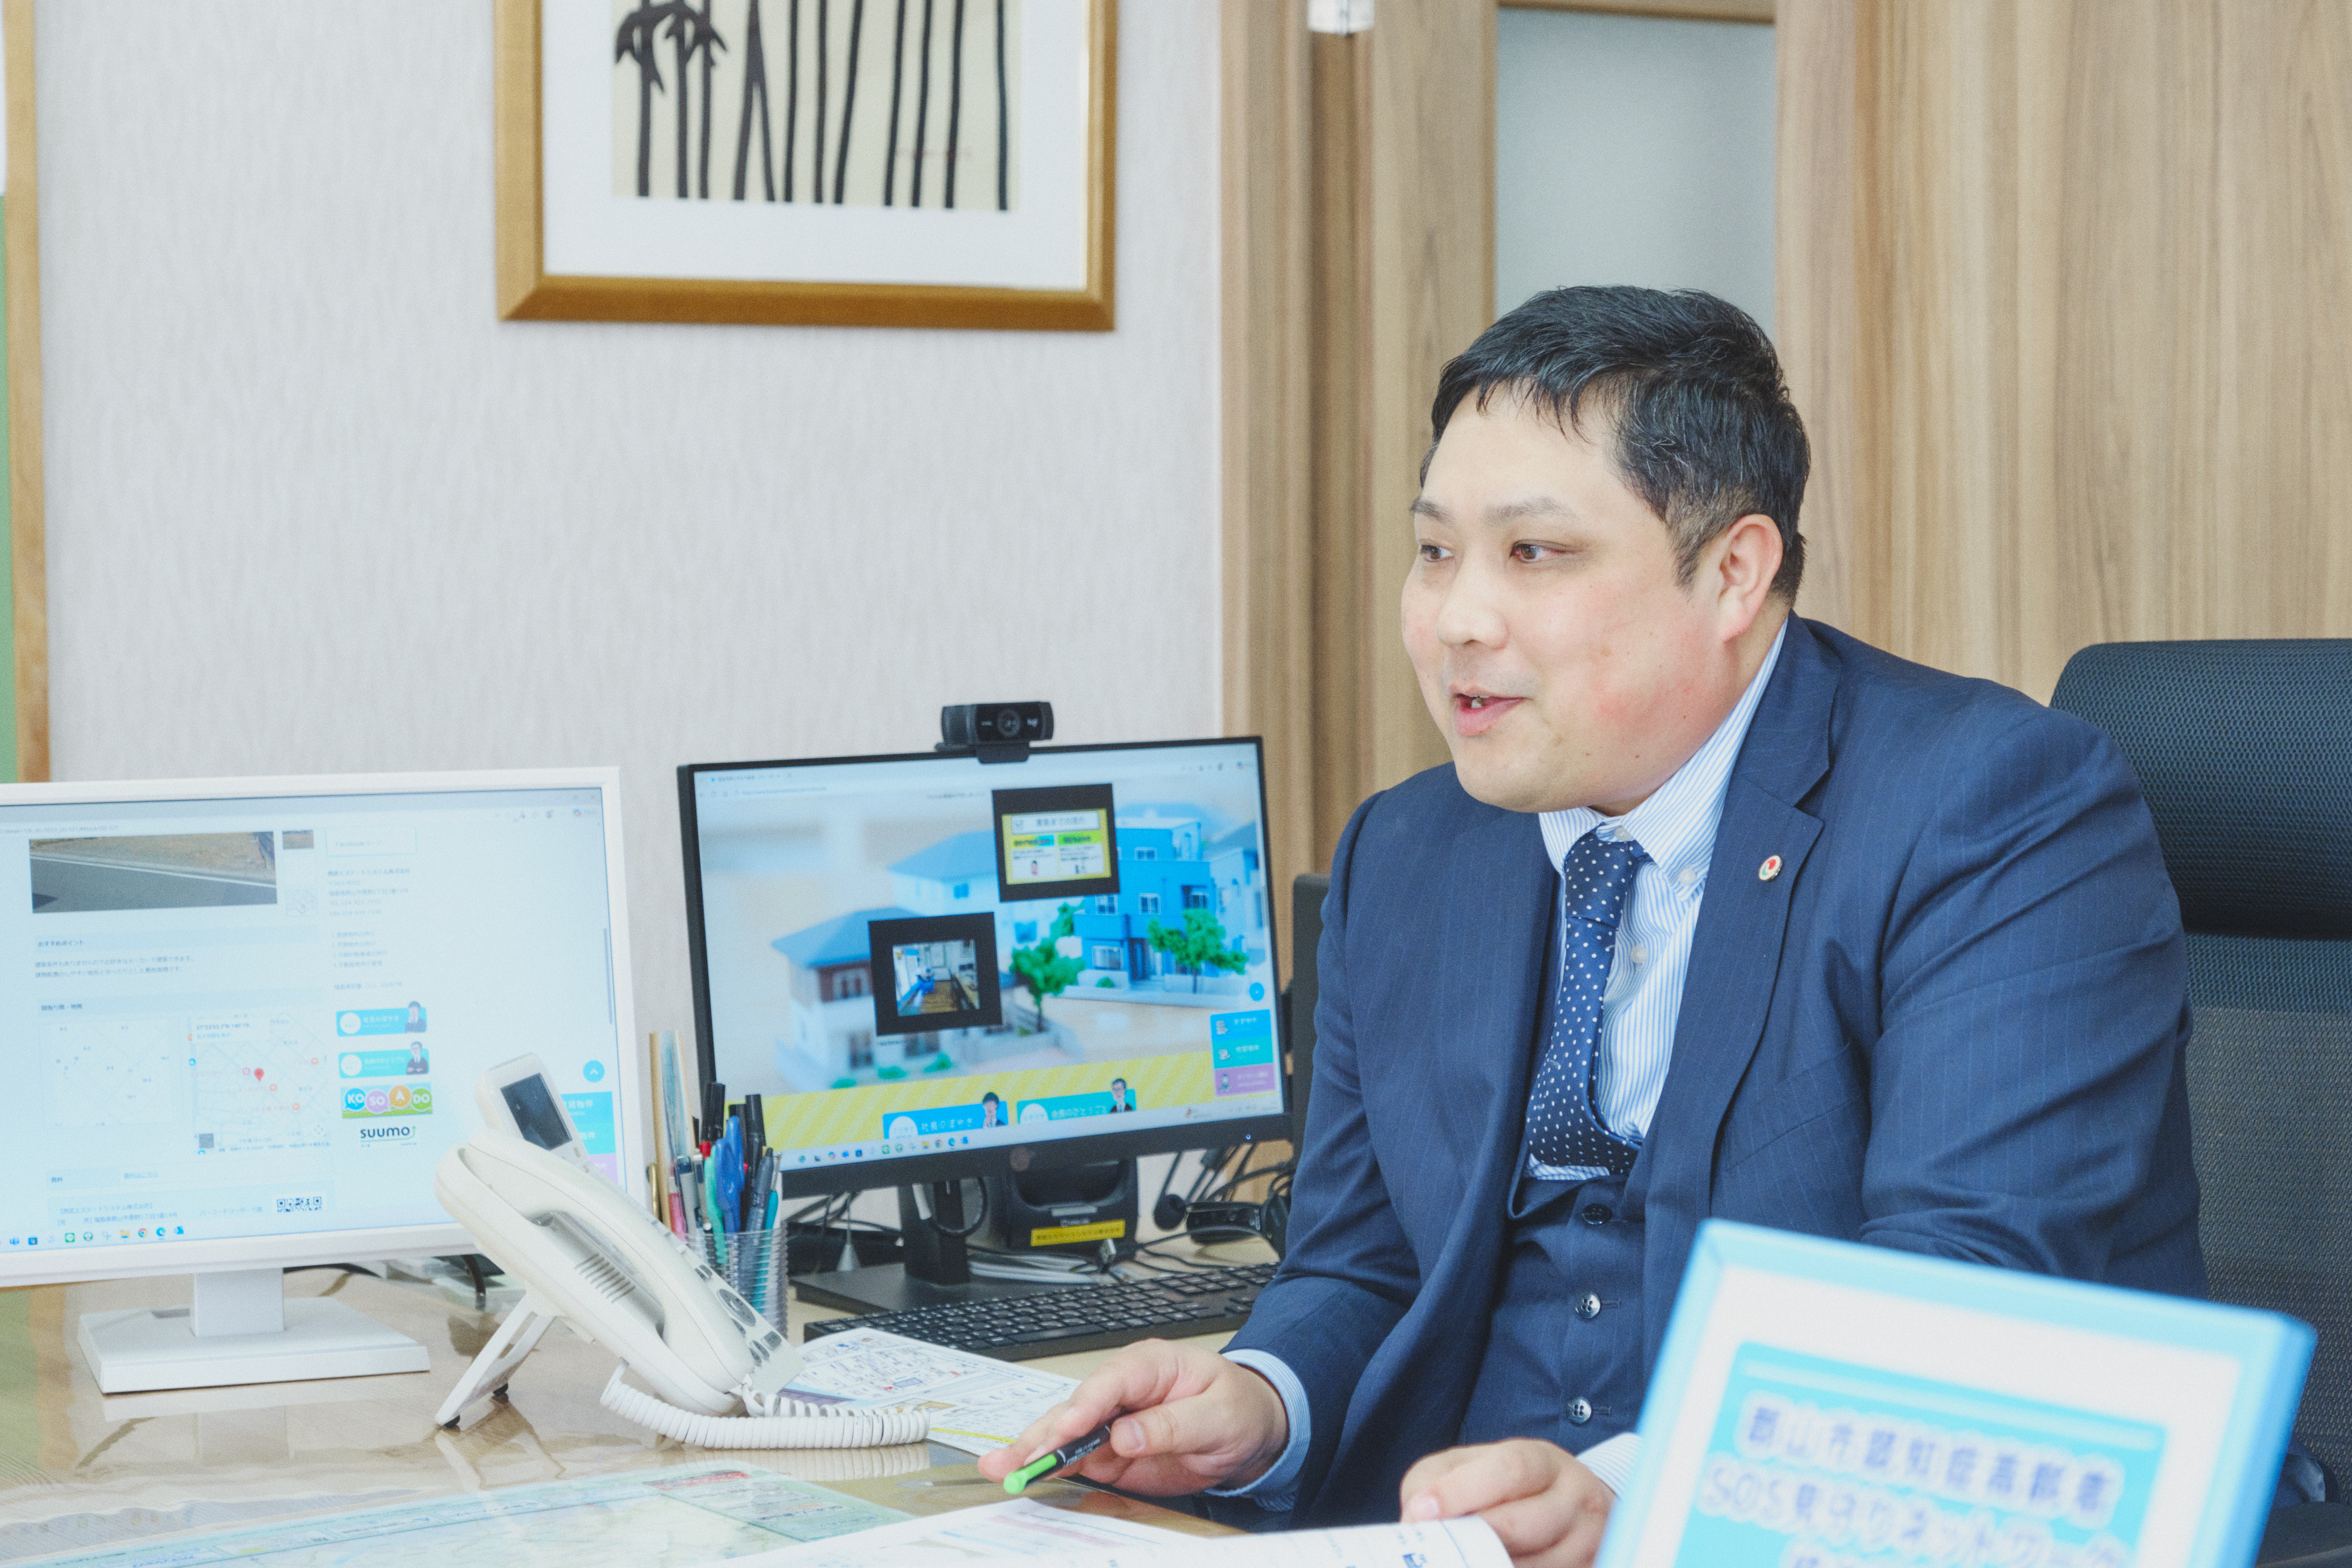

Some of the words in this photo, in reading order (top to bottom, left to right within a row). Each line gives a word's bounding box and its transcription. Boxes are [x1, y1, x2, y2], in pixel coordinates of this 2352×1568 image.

[347, 1093, 365, 1104] KO
[369, 1096, 385, 1106] SO
[395, 1091, 406, 1101] A
[413, 1093, 430, 1104] DO
[360, 1125, 410, 1139] suumo
